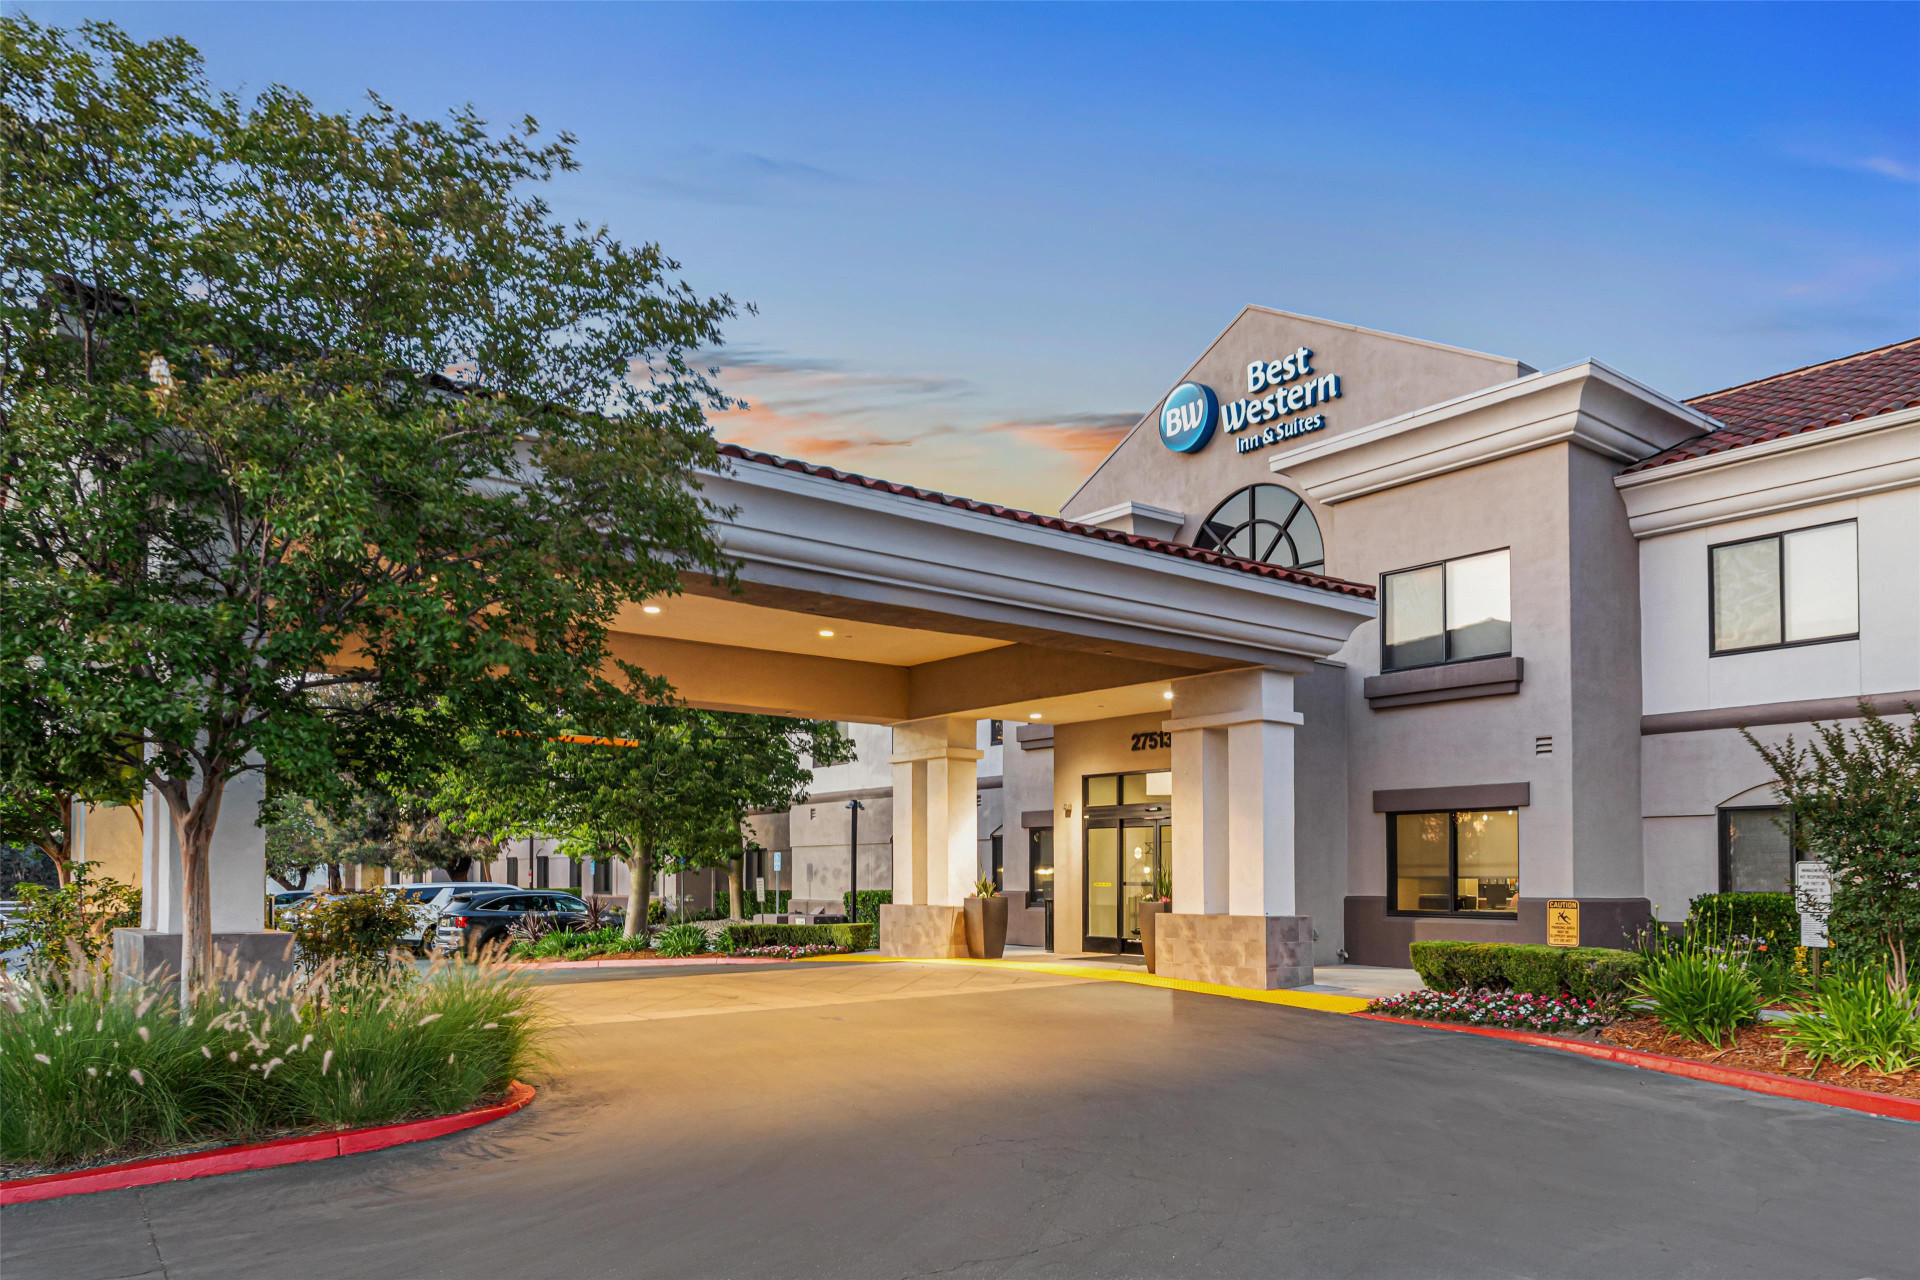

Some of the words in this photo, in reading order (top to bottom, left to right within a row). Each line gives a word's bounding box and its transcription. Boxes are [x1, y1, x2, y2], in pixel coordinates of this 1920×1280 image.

[1247, 346, 1309, 393] Best
[1166, 398, 1203, 437] BW
[1220, 373, 1338, 433] Western
[1236, 434, 1260, 453] Inn
[1262, 427, 1275, 444] &
[1276, 414, 1322, 440] Suites
[1131, 731, 1171, 751] 27513
